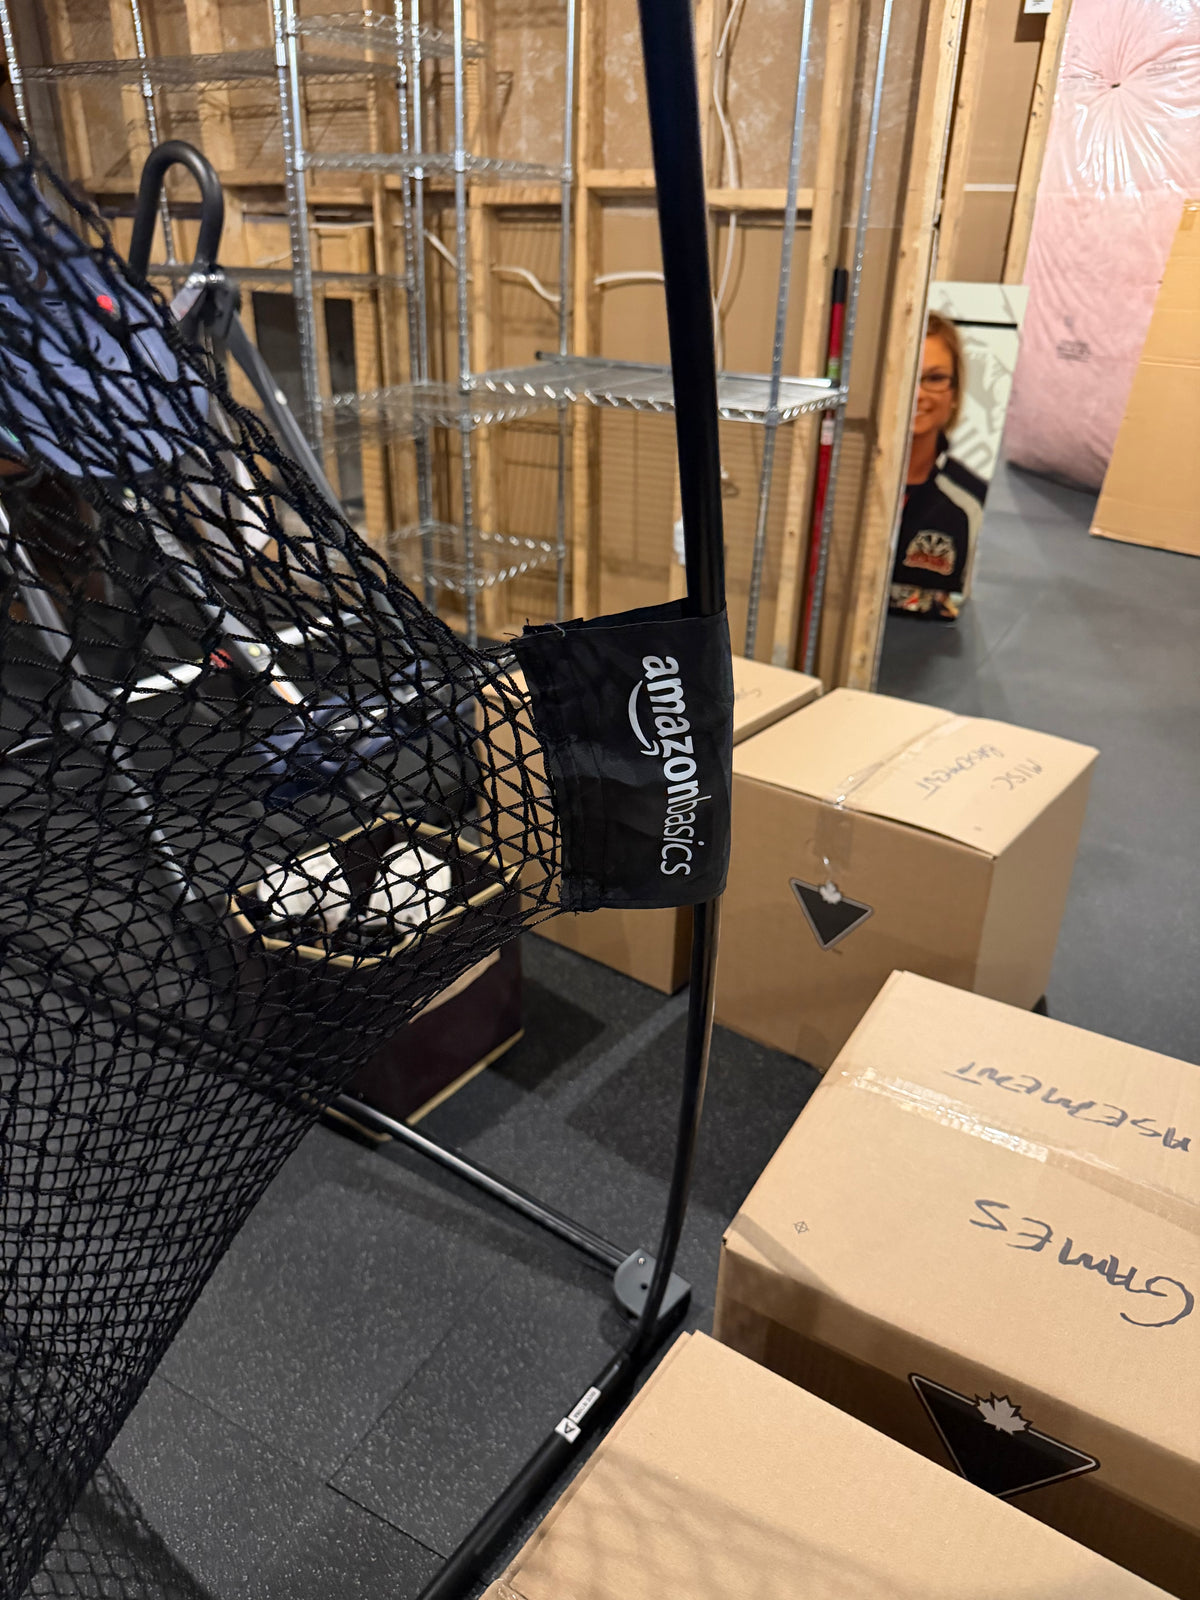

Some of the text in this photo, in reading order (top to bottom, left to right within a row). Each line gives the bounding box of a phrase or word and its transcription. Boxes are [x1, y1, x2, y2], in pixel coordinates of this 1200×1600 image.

[641, 655, 712, 876] amazonbasics
[942, 1060, 1190, 1152] ASEMENT
[969, 1198, 1195, 1328] GAMES
